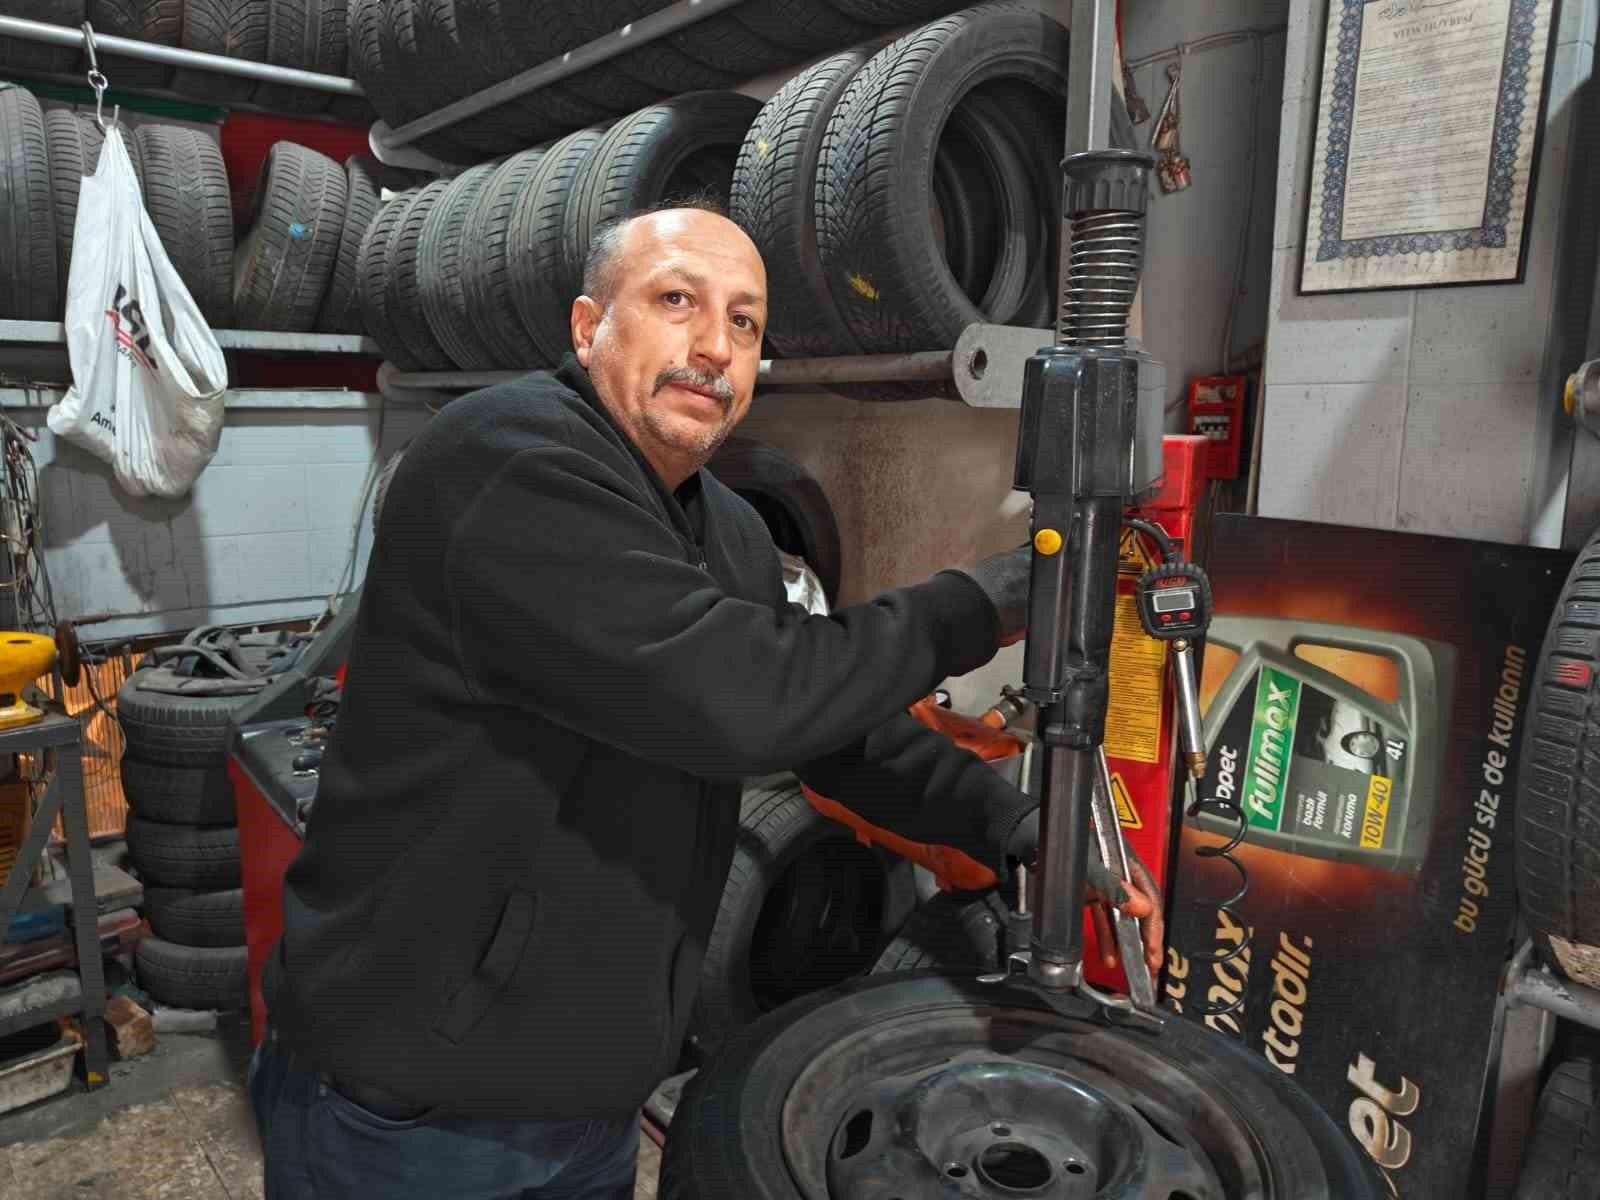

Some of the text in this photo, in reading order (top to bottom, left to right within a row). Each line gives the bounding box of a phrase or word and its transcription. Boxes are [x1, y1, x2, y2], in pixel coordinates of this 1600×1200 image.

[1248, 680, 1292, 820] fullmax
[1385, 740, 1405, 760] 4L
[1454, 643, 1527, 933] bu gücü siz de kullanın
[1363, 780, 1389, 845] 10W-40
